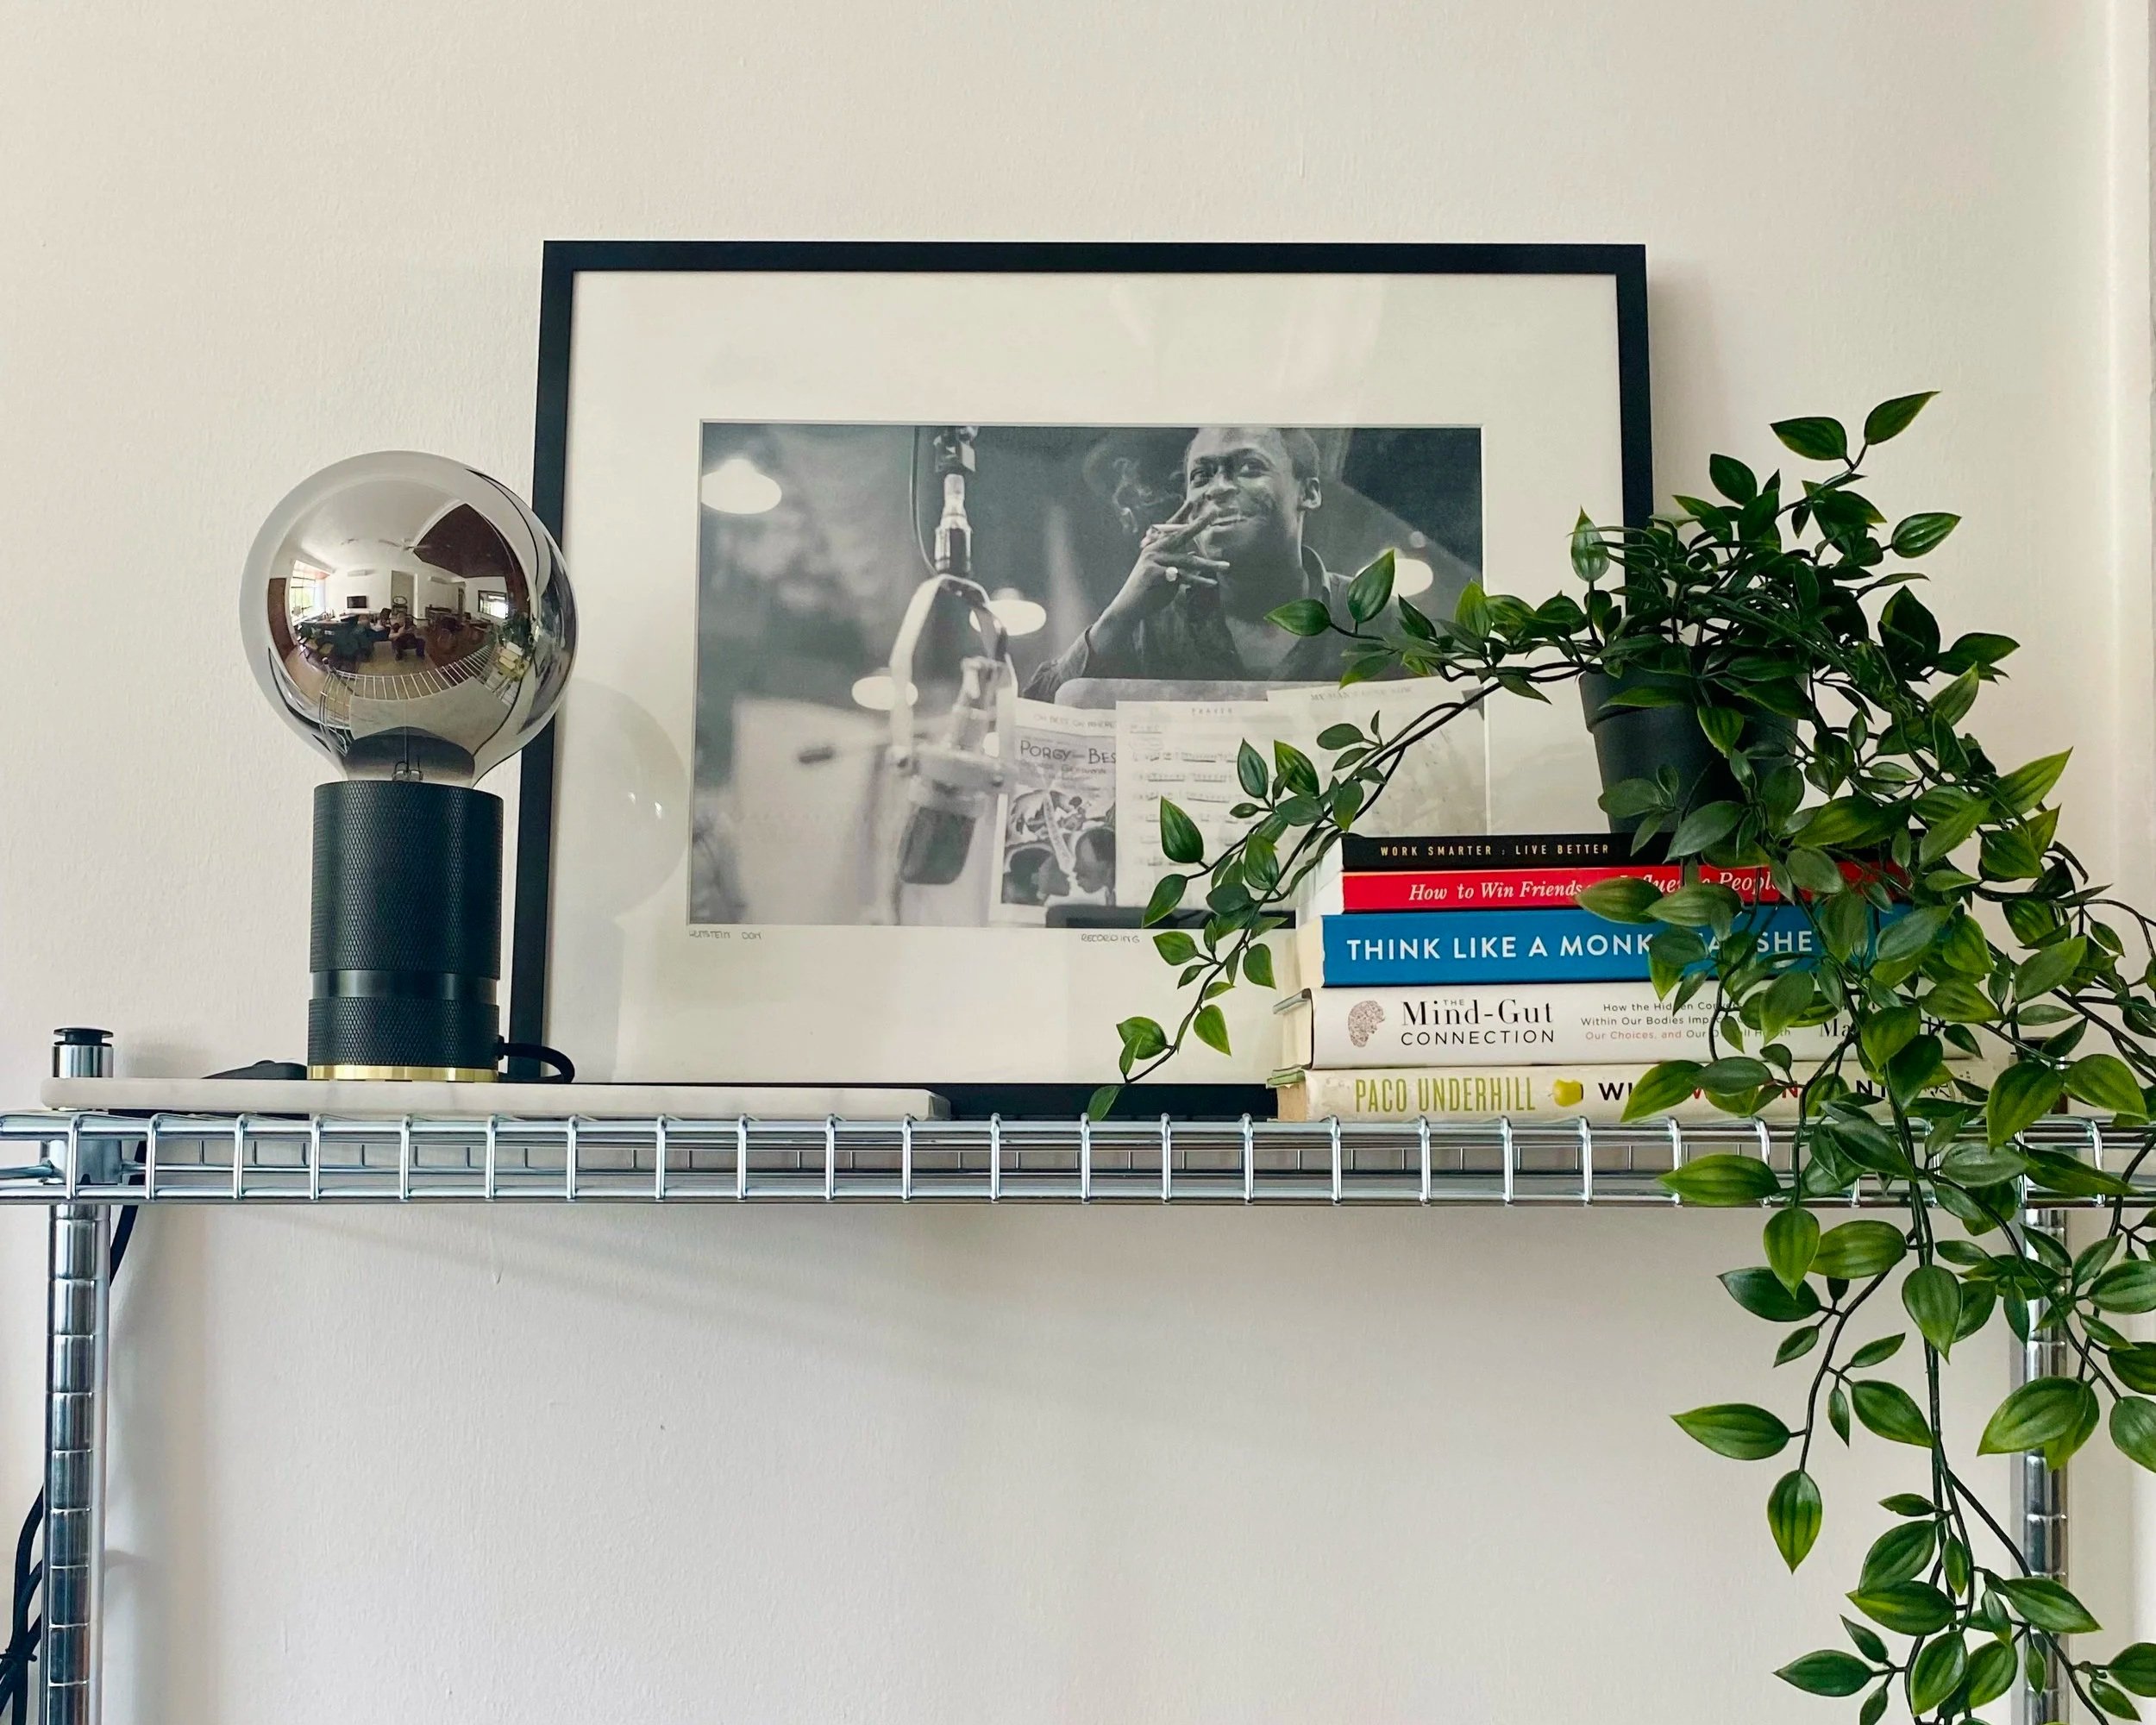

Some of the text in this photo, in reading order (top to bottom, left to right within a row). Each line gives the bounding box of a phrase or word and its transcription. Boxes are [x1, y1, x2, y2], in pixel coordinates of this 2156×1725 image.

[1020, 739, 1071, 762] PORGY
[1088, 748, 1116, 764] BES
[1380, 846, 1418, 856] WORK
[1427, 845, 1492, 856] SMARTER
[1515, 844, 1547, 855] LIVE
[1557, 844, 1608, 855] BETTER
[1409, 882, 1447, 900] How
[1457, 883, 1474, 900] to
[1481, 881, 1514, 899] Win
[1519, 880, 1582, 898] Friends
[1081, 933, 1140, 944] RECORDING
[1346, 938, 1441, 961] THINK
[1453, 937, 1516, 959] LIKE
[1528, 936, 1548, 957] A
[1559, 933, 1654, 957] MONK
[1401, 998, 1554, 1026] Mind-Gut
[1603, 1003, 1627, 1012] How
[1654, 1002, 1694, 1011] Hiden
[1581, 1017, 1618, 1026] Within
[1621, 1017, 1642, 1026] Our
[1646, 1016, 1684, 1025] Bodies
[1401, 1029, 1554, 1046] CONNECTION
[1586, 1032, 1606, 1040] Our
[1661, 1030, 1682, 1038] and
[1686, 1029, 1706, 1038] Our
[1355, 1076, 1536, 1113] PACO UNDERHILL
